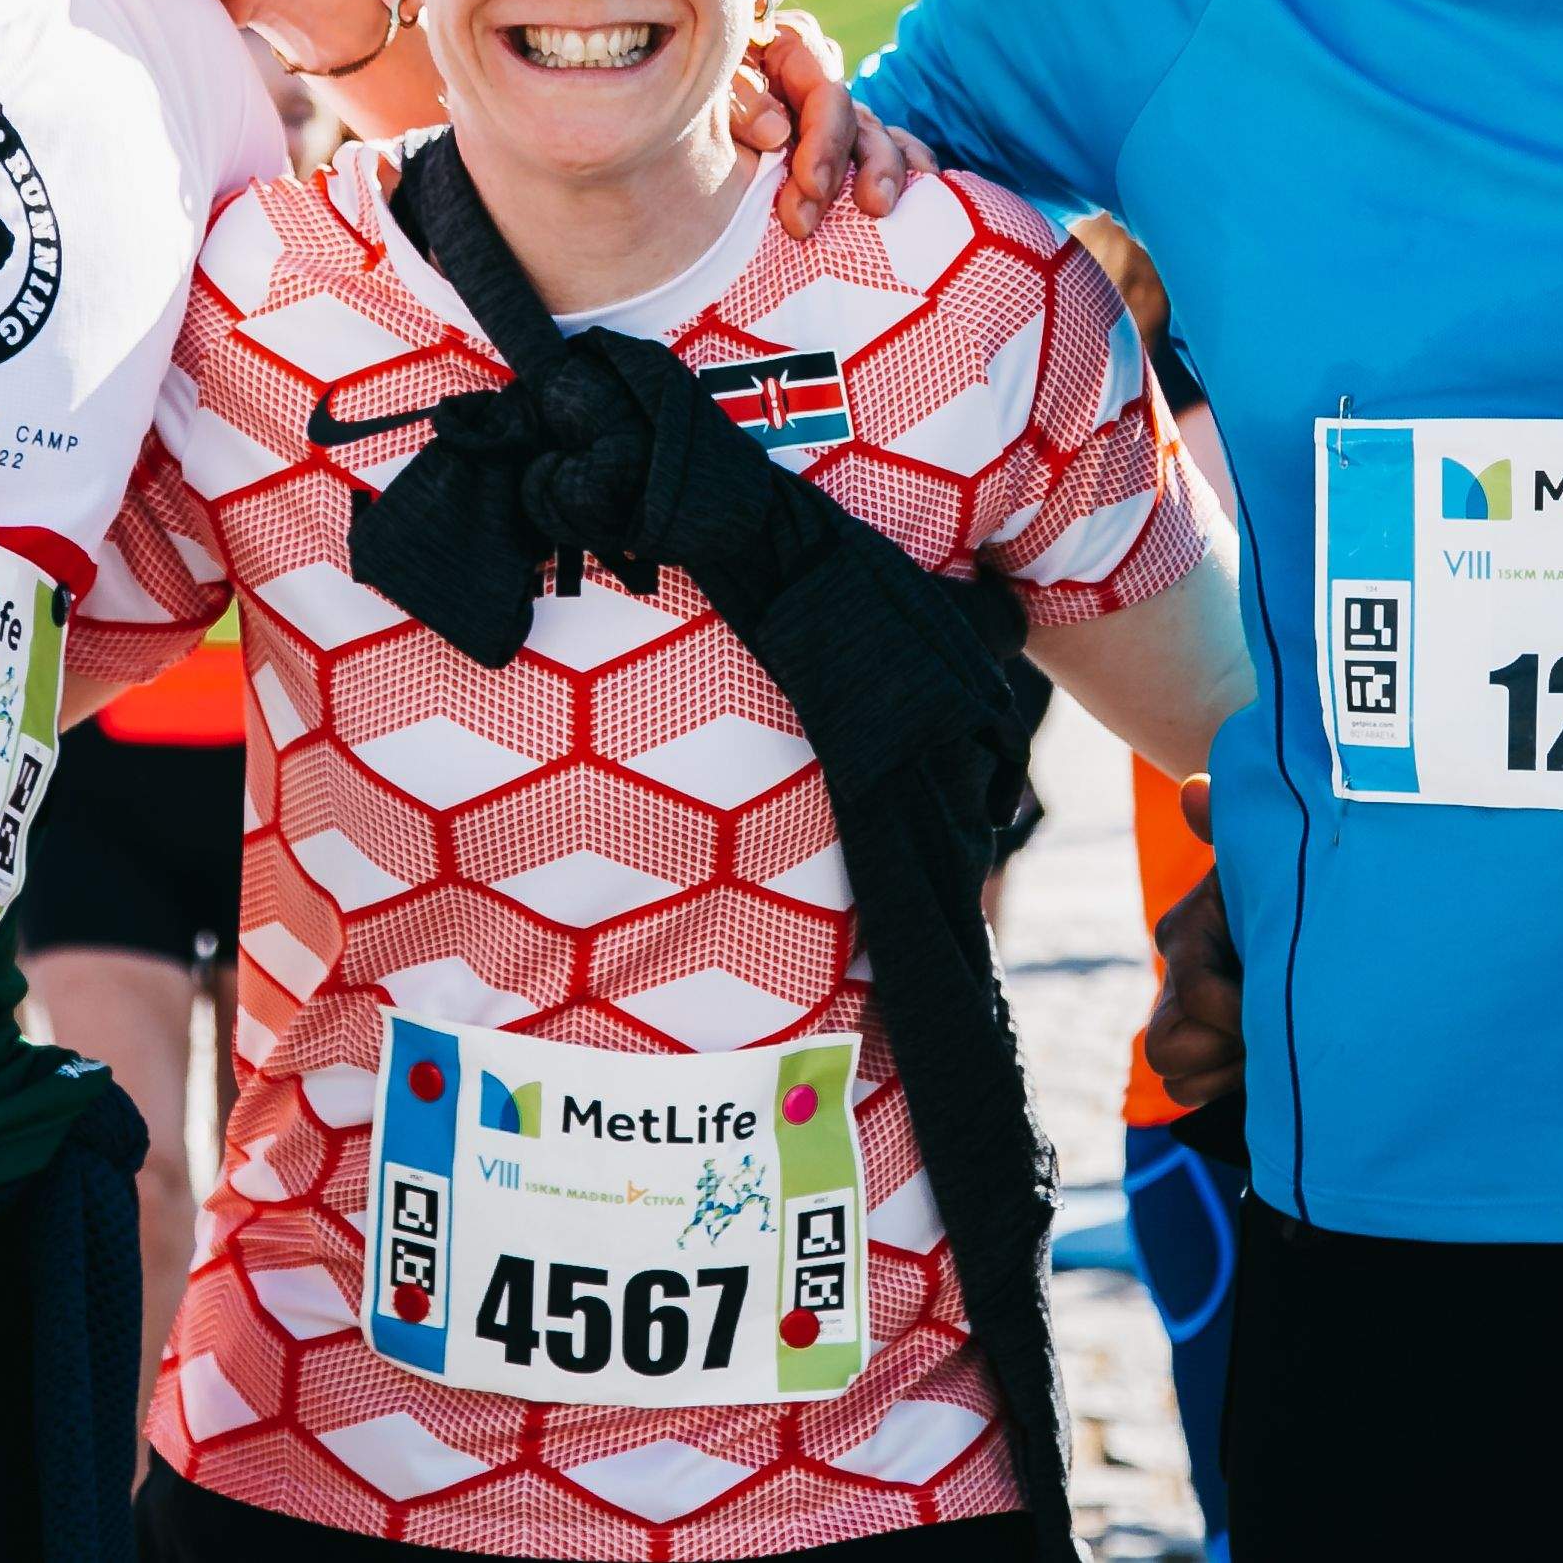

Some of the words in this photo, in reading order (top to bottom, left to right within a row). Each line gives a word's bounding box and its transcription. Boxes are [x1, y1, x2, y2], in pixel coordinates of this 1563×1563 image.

[0, 148, 58, 346] RUNNING
[16, 425, 79, 454] CAMP
[1443, 550, 1491, 579] VIII
[1497, 568, 1537, 580] 15KM
[561, 1094, 758, 1145] MetLife
[477, 1154, 520, 1191] VIII
[524, 1181, 562, 1196] 15KM
[565, 1188, 625, 1205] MADRID
[475, 1252, 750, 1377] 4567
